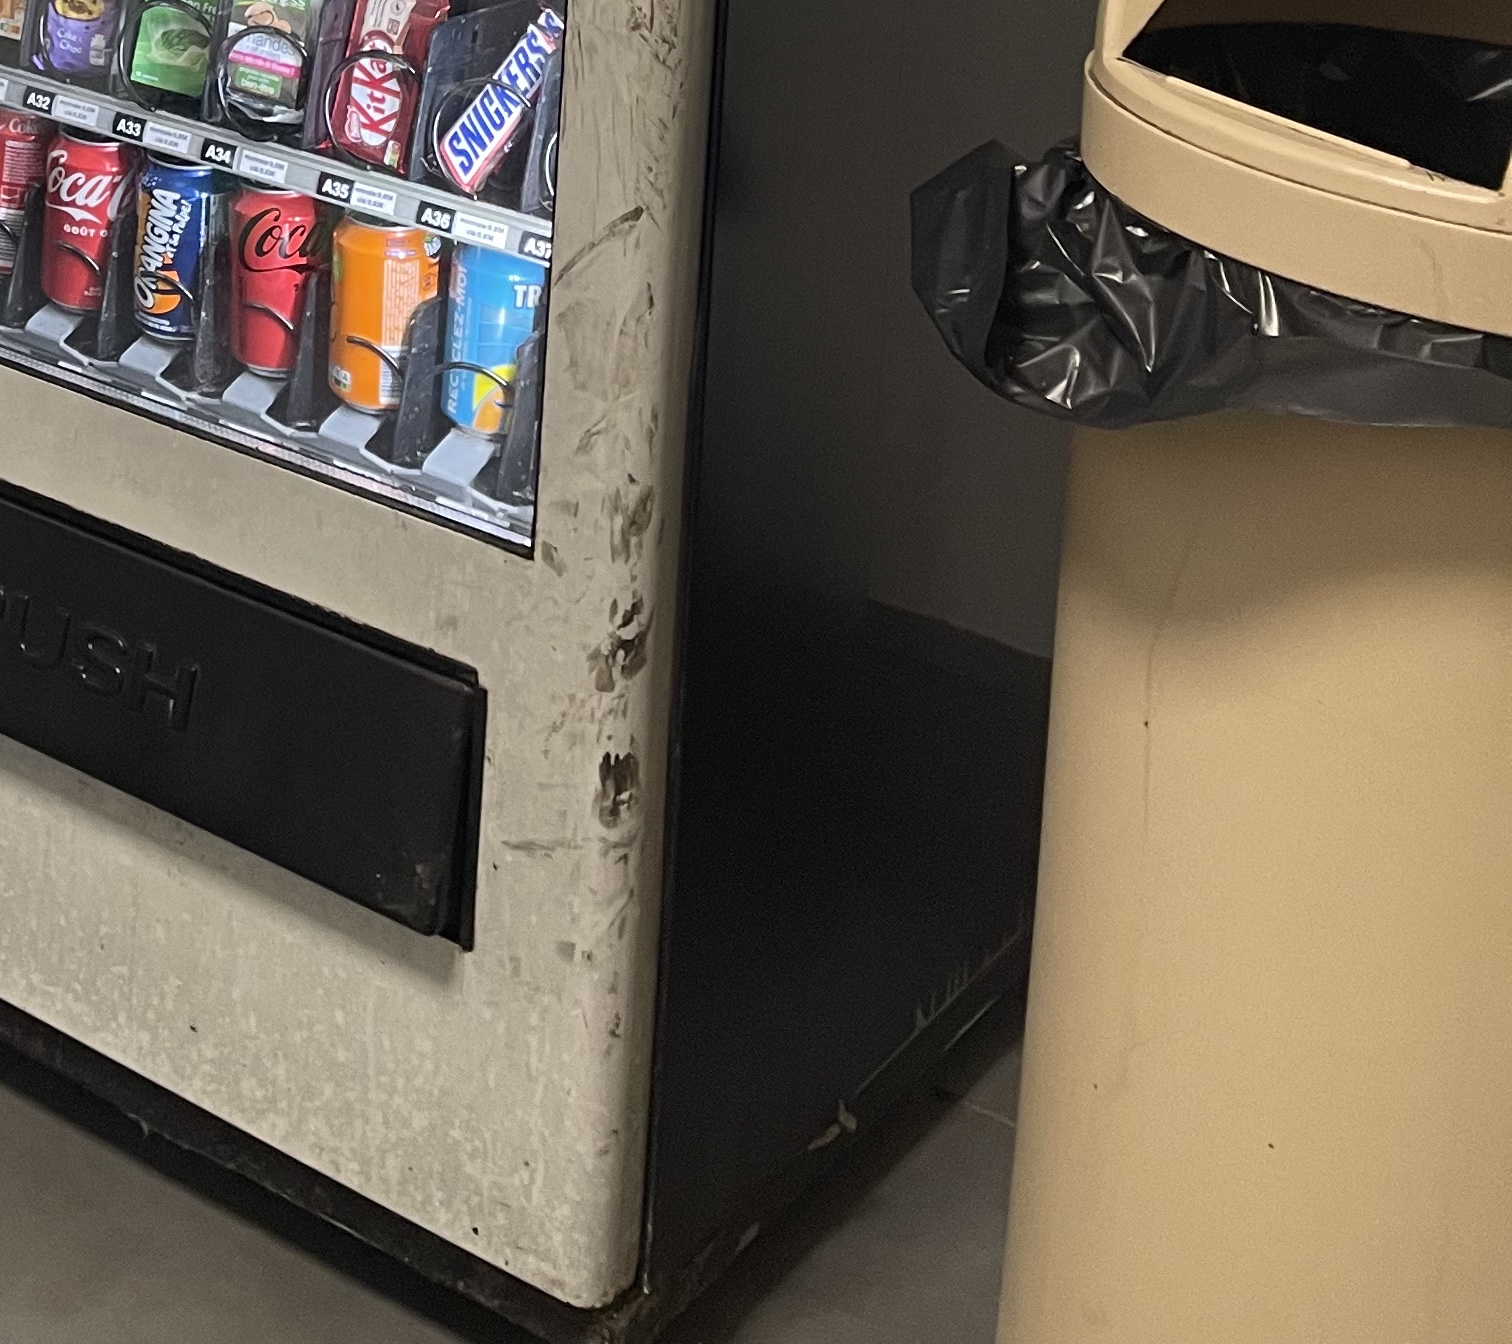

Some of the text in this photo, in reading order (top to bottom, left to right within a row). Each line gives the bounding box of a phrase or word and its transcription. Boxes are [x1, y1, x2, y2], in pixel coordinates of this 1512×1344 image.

[26, 91, 52, 110] A32
[448, 29, 546, 177] SNICKERS
[116, 118, 142, 137] A33
[205, 143, 232, 164] A34
[321, 178, 350, 199] A35
[420, 208, 450, 230] A36
[63, 223, 95, 238] GOÛT
[134, 188, 181, 309] ORANGINA
